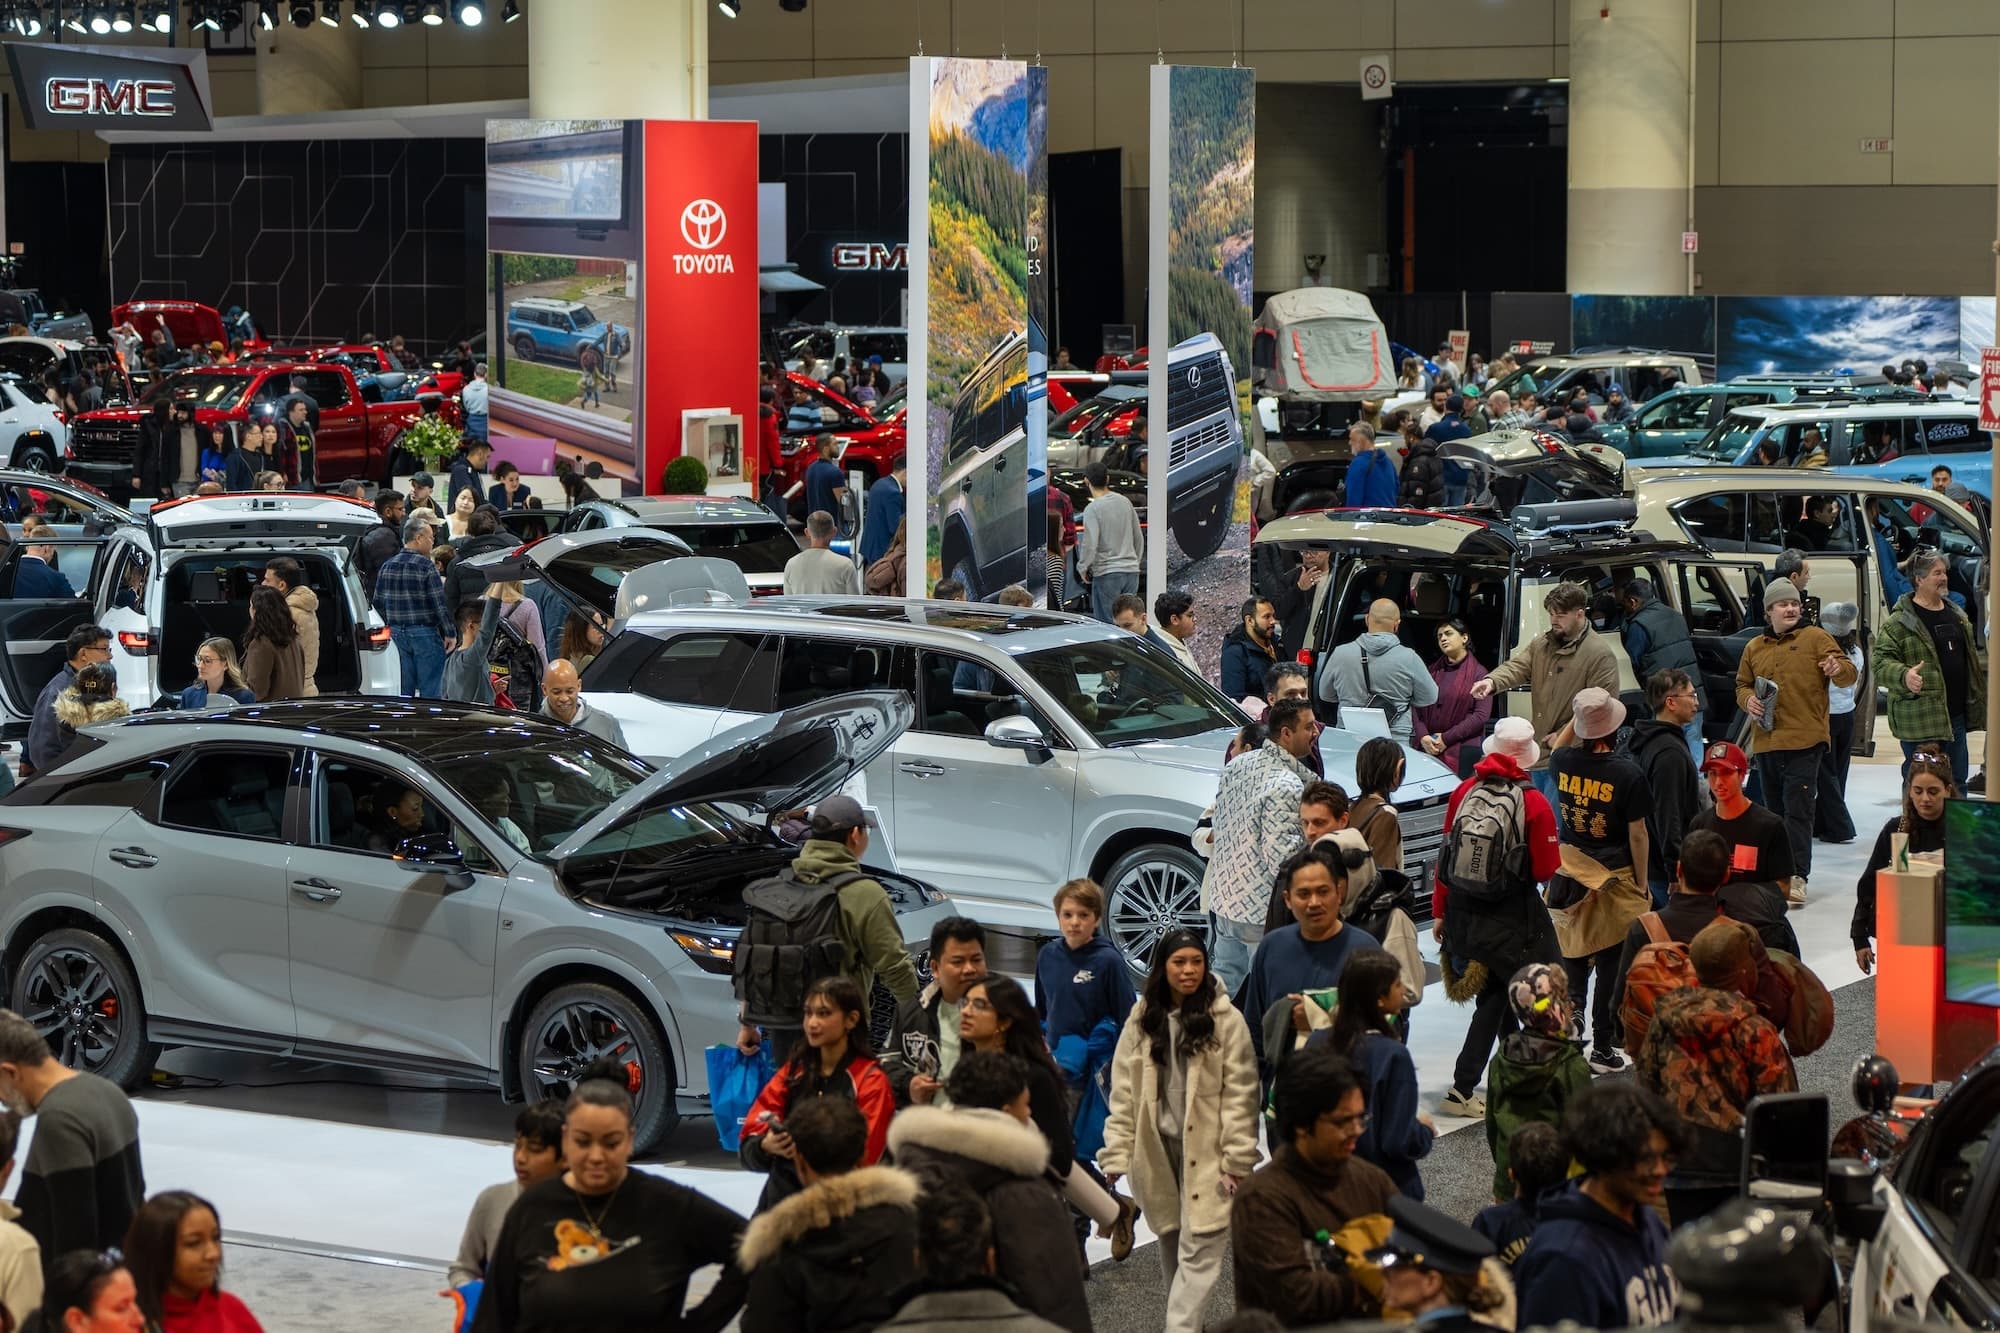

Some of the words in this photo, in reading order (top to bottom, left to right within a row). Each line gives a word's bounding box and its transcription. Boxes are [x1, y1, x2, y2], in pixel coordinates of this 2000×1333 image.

[46, 77, 176, 116] GMC
[672, 254, 735, 275] TOYOTA
[832, 243, 909, 270] GM
[1027, 259, 1041, 276] ES
[1558, 771, 1614, 803] RAMS
[1574, 795, 1589, 807] '24
[1470, 845, 1483, 875] ROOTS
